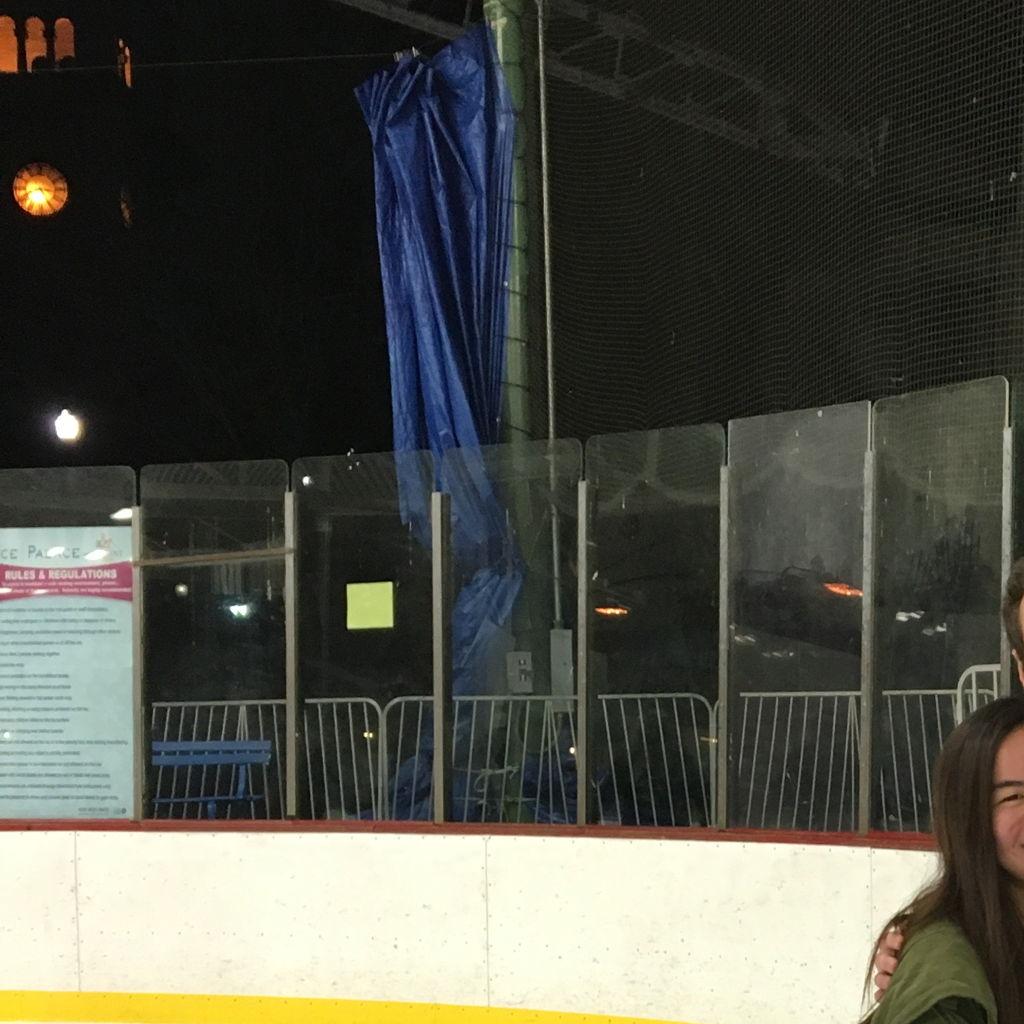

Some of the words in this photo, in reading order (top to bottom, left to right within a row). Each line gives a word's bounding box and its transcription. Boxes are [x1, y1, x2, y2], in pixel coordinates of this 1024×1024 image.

[0, 547, 18, 560] CE
[28, 545, 80, 560] PALCE
[5, 569, 36, 581] RULES
[39, 570, 46, 580] &
[48, 568, 118, 581] REGULATIONS
